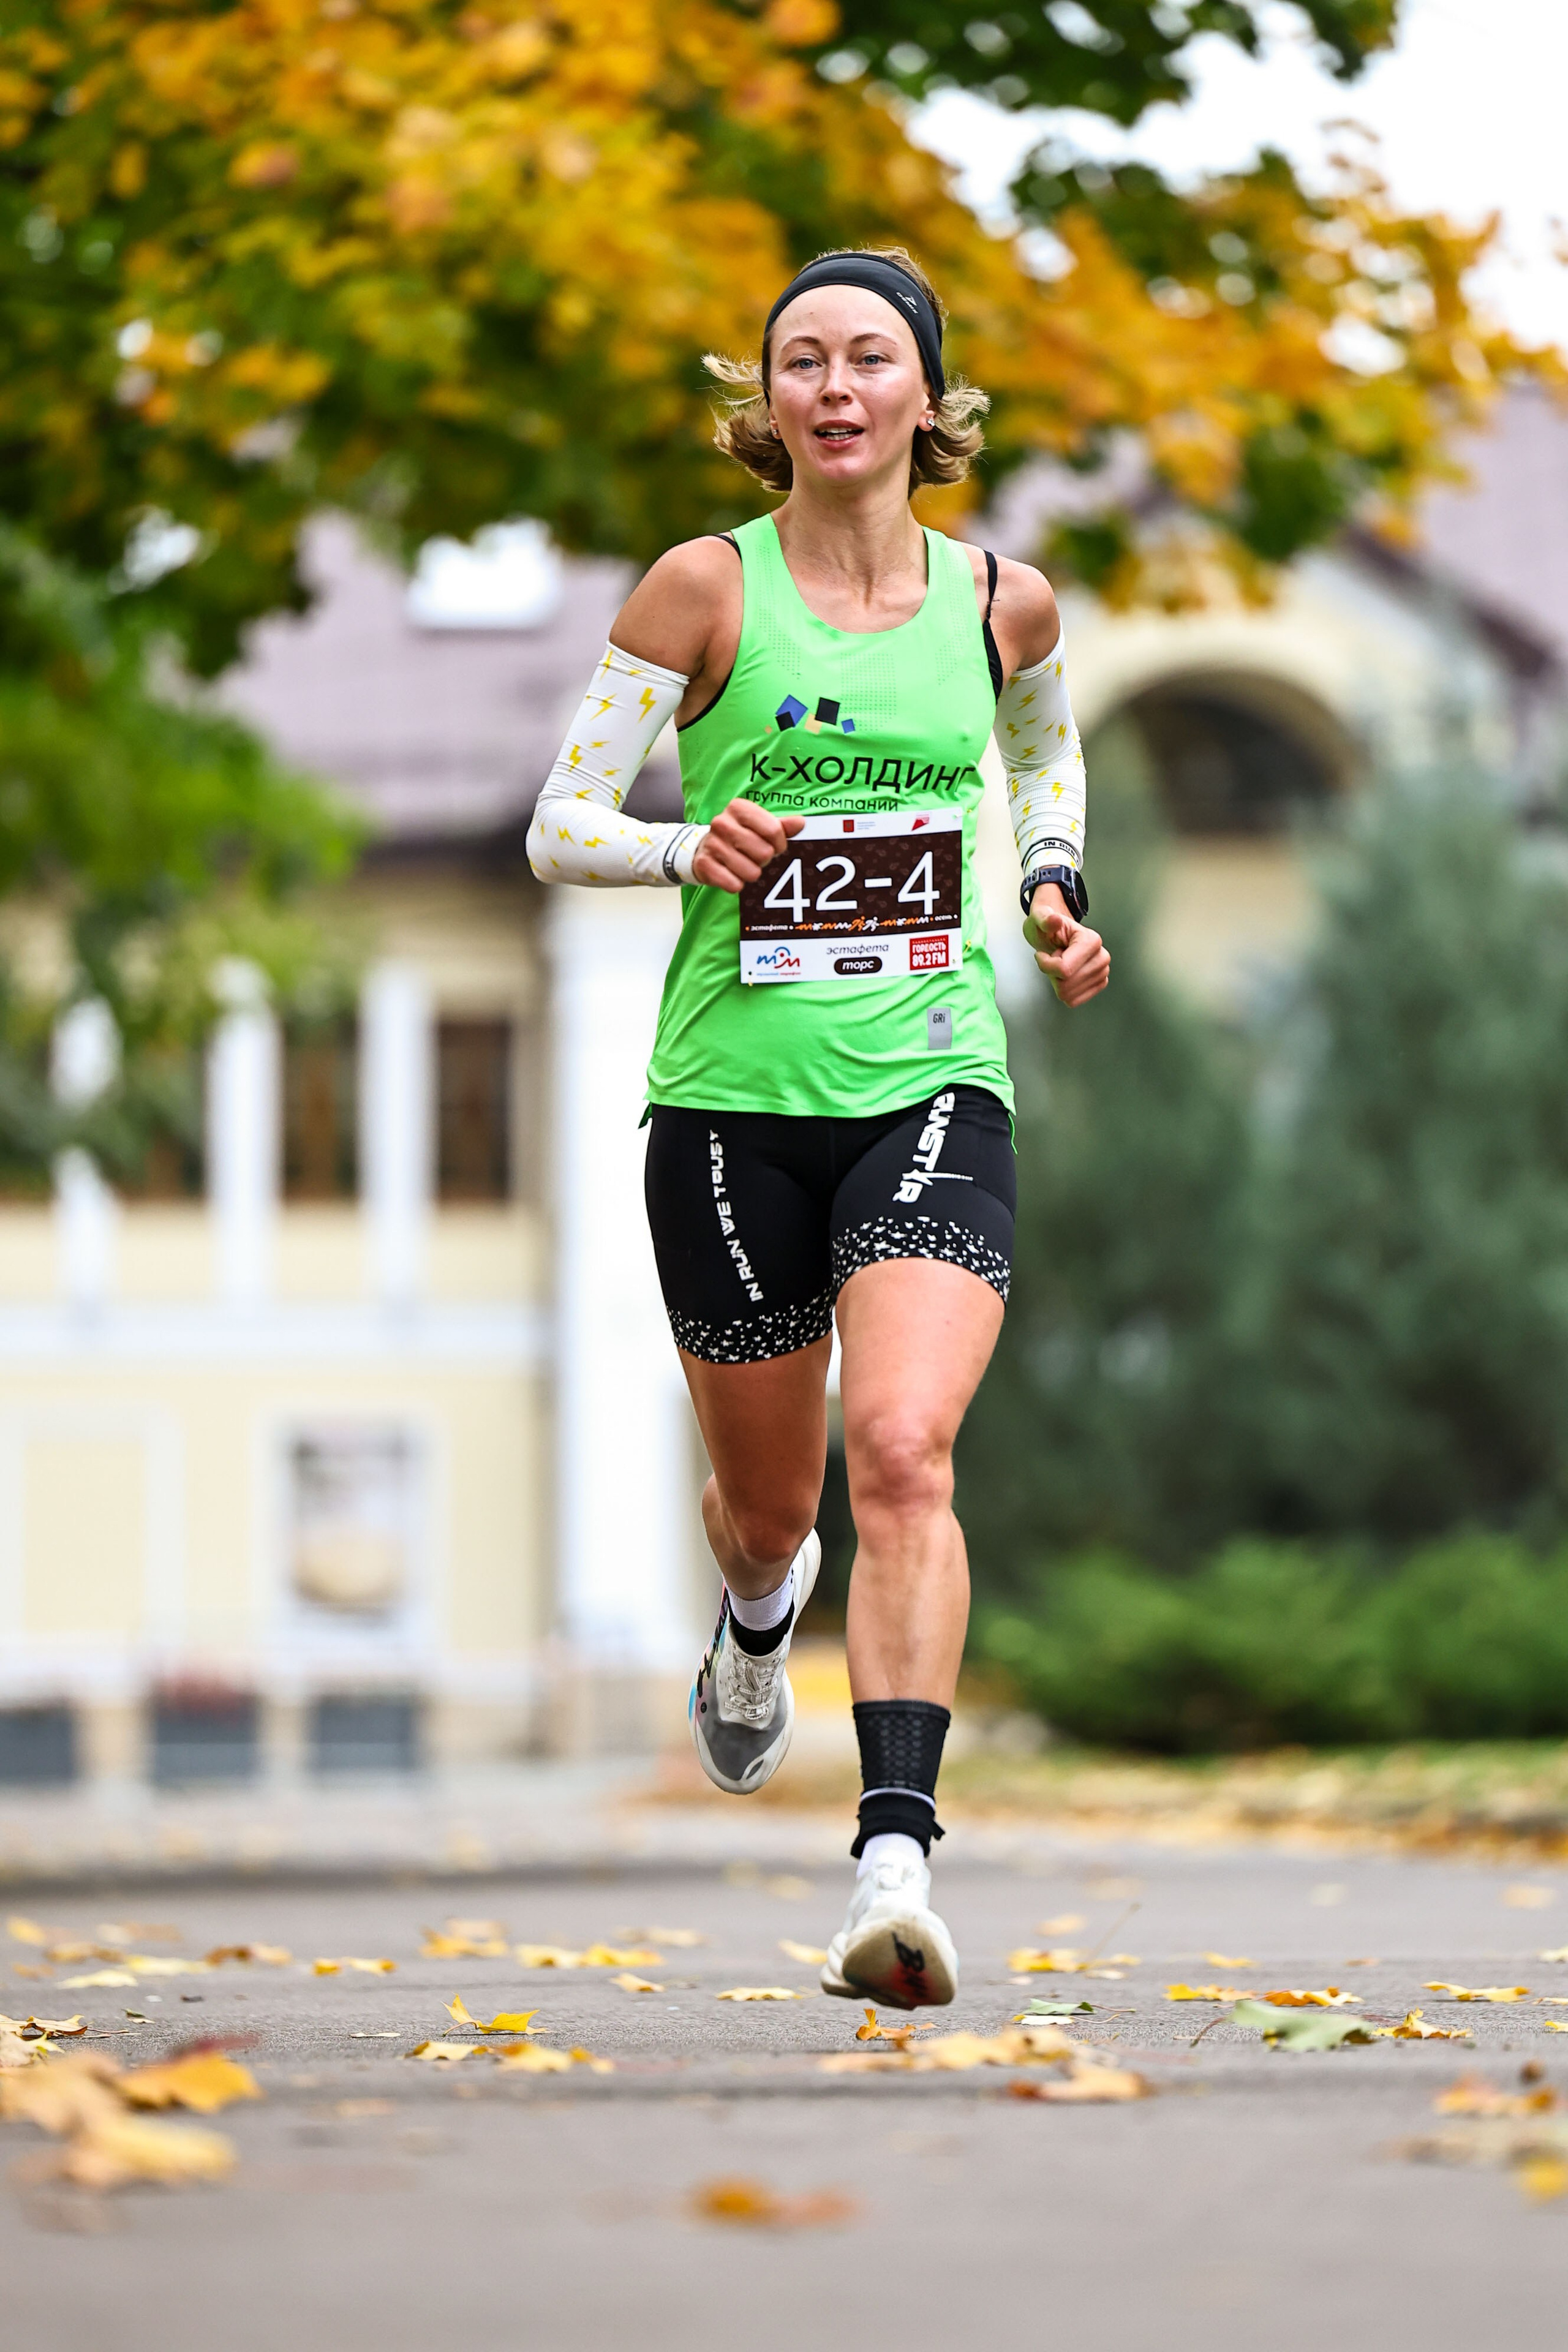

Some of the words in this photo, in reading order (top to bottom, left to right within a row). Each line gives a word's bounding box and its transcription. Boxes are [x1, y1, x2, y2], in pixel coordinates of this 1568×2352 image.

[750, 753, 976, 794] К-ХОЛДИНГ
[745, 790, 804, 806] группа
[1059, 843, 1076, 856] RUN
[763, 850, 941, 923] 42-4
[826, 943, 889, 955] эстафета
[912, 952, 932, 967] 89.2
[932, 951, 946, 965] FM
[717, 1200, 736, 1237] WE
[727, 1238, 755, 1281] RUN
[746, 1282, 764, 1302] IN
